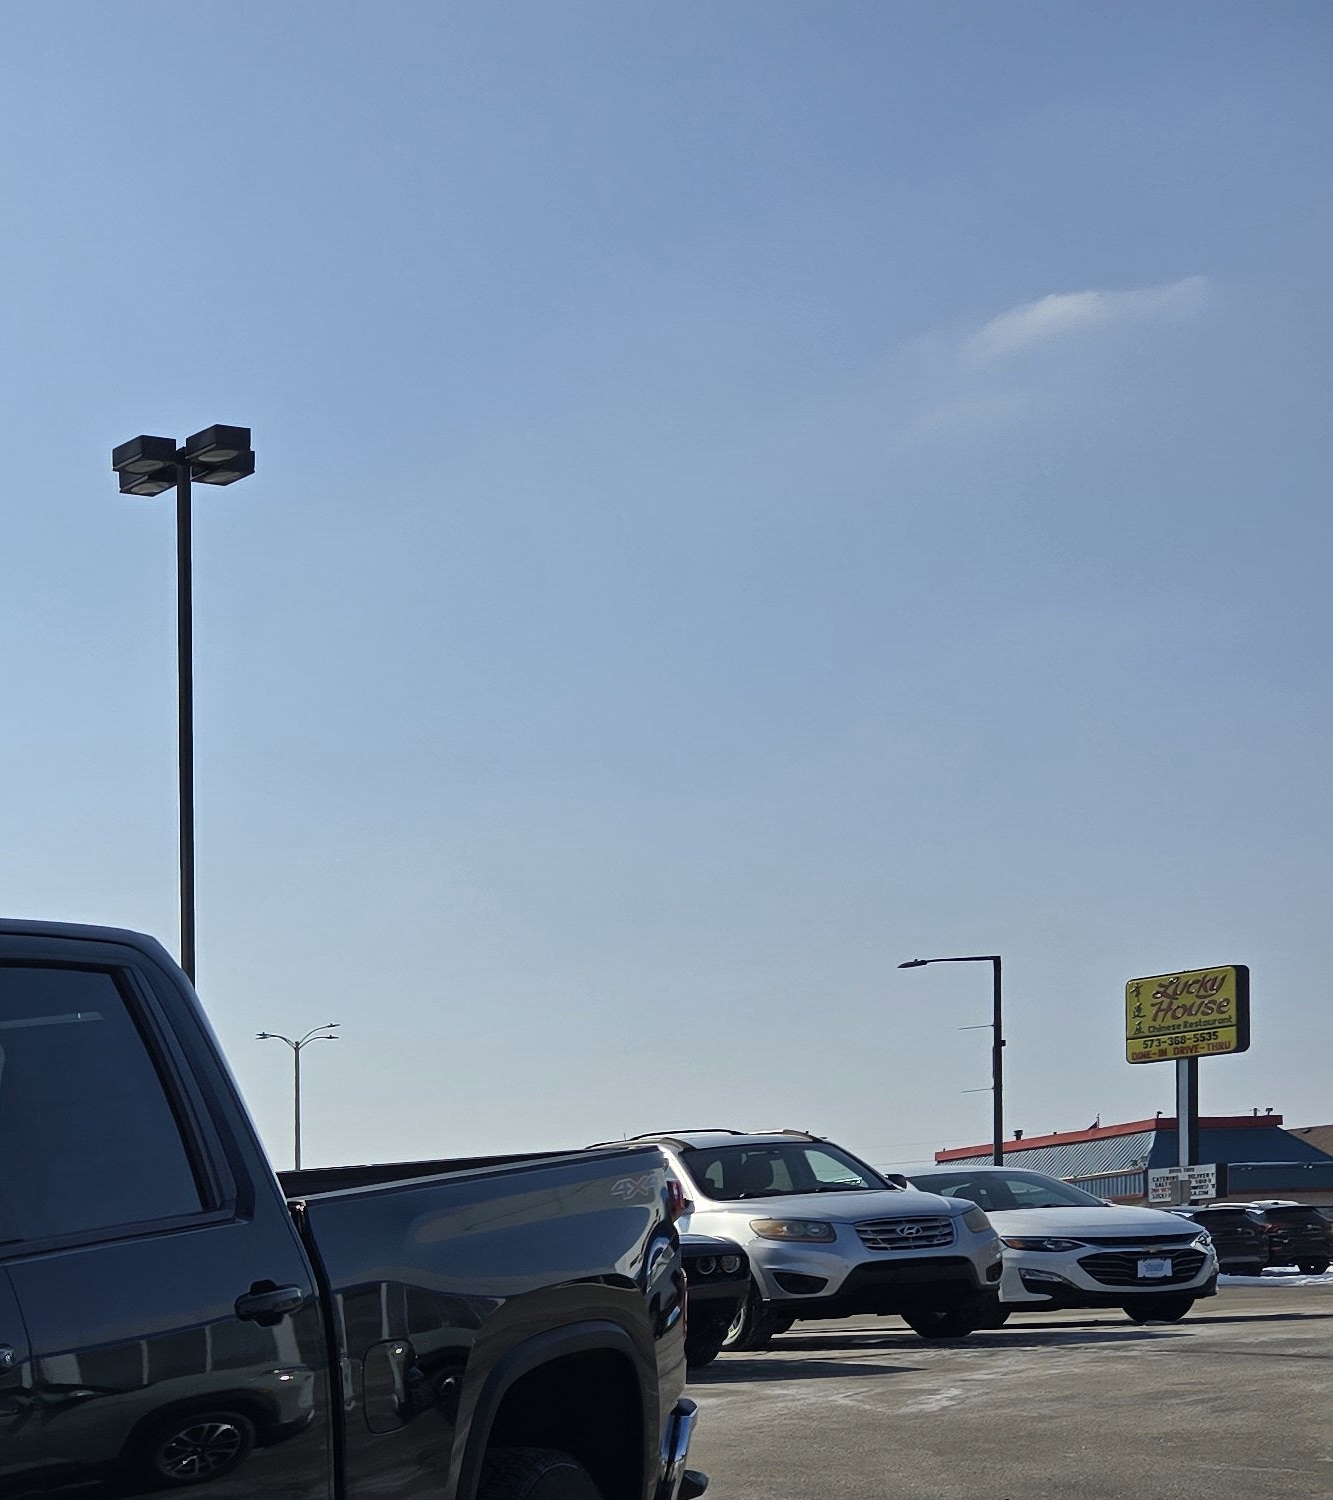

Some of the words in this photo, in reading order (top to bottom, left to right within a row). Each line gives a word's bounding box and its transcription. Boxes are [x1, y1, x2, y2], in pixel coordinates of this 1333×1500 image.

[1152, 974, 1228, 1000] Lucky
[1150, 997, 1231, 1023] House
[1147, 1023, 1182, 1034] Chinese
[1182, 1015, 1233, 1030] Restaurant
[1173, 1040, 1231, 1056] DRIVE-THRU
